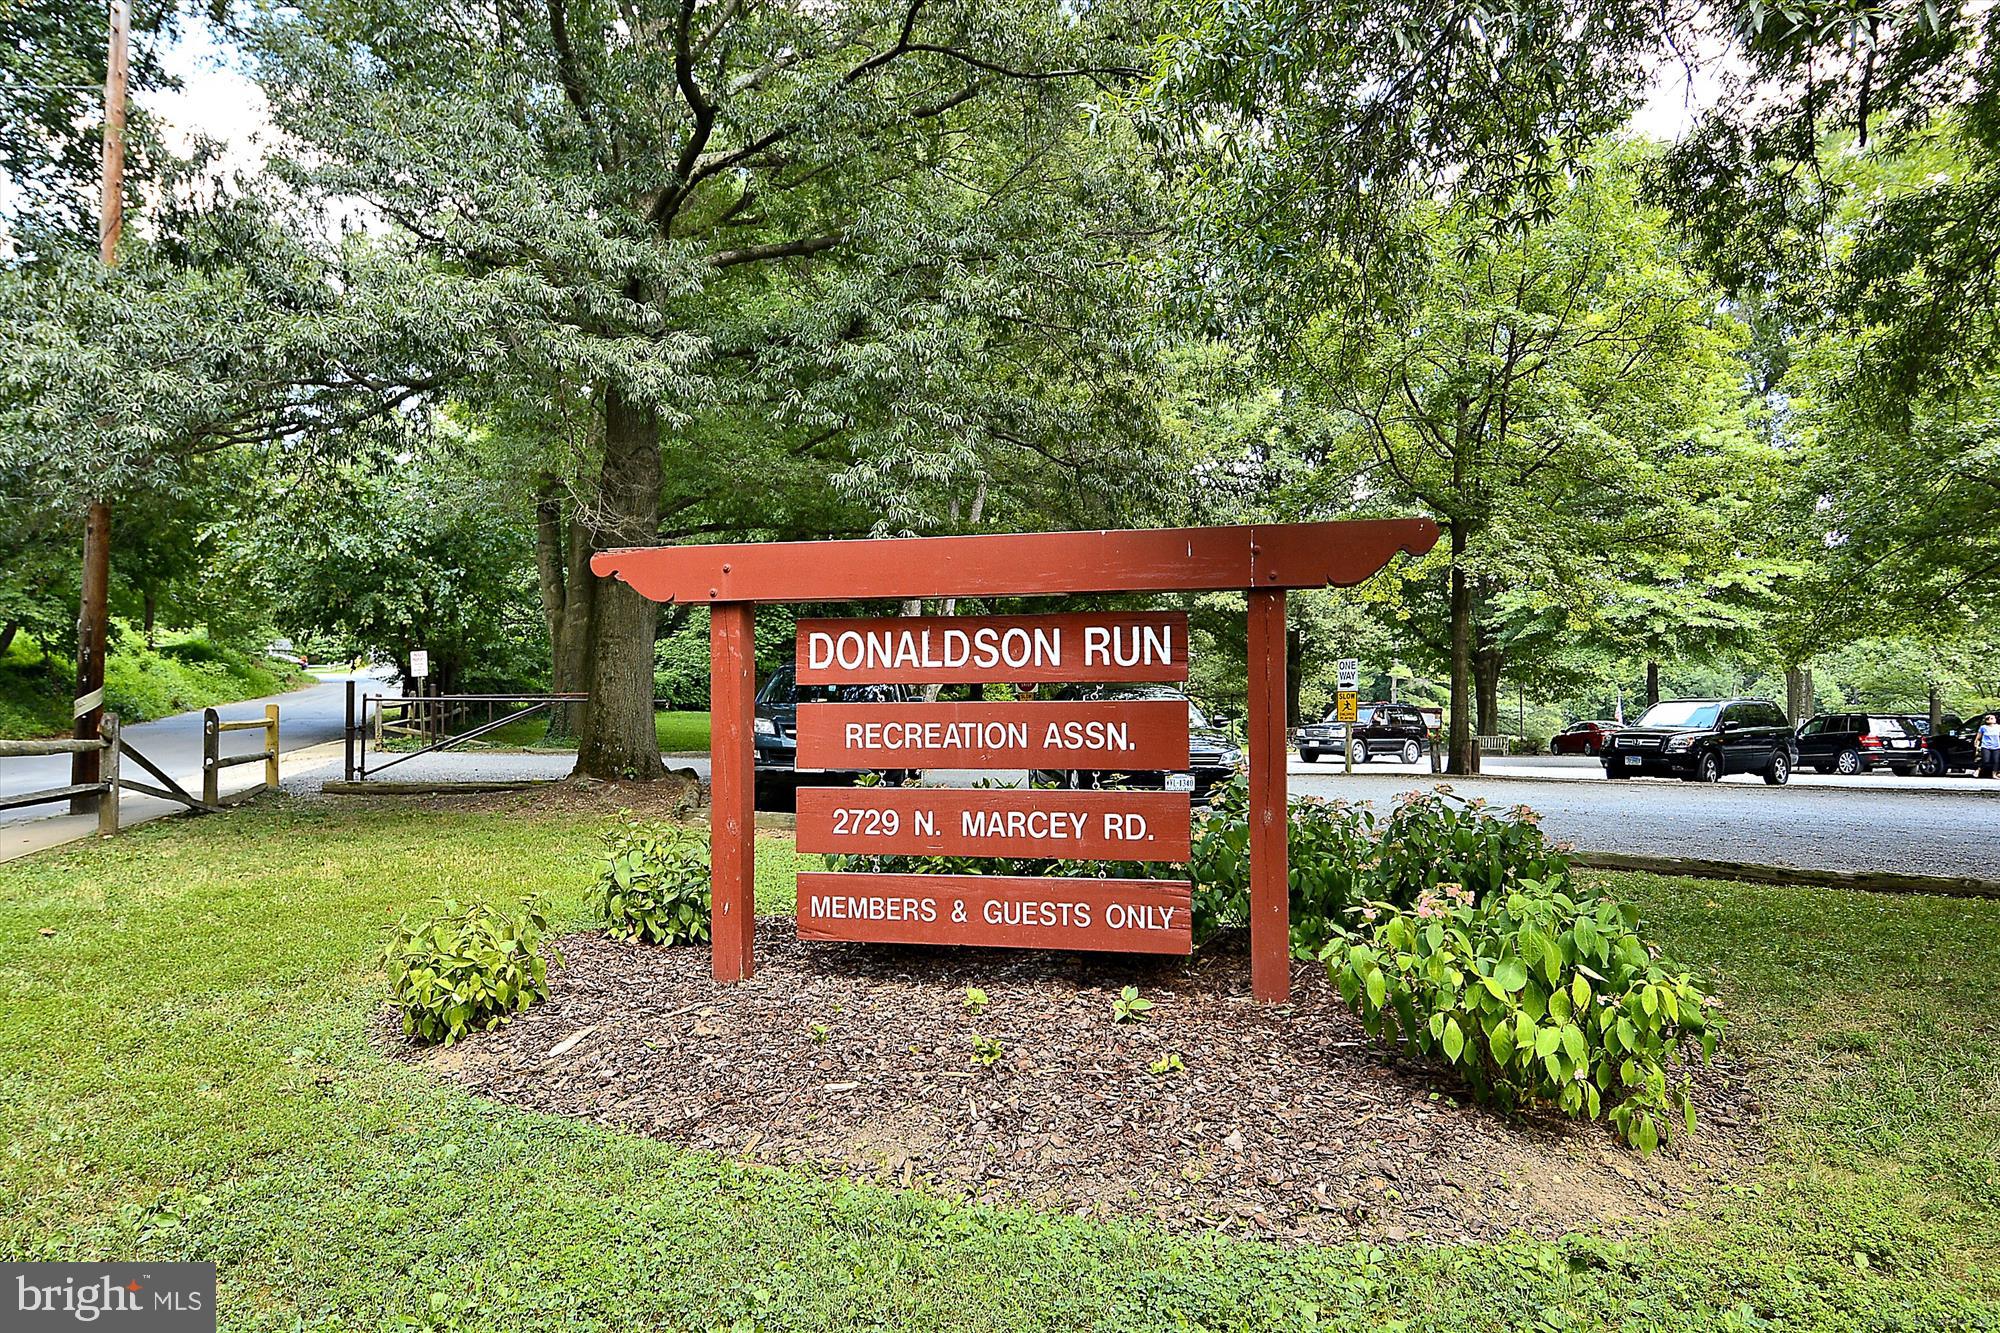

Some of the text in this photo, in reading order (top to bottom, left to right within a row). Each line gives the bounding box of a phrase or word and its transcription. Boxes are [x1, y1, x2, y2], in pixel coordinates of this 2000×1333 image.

[808, 625, 1172, 670] DONALDSON RUN
[1339, 661, 1356, 670] ONE
[1339, 671, 1356, 680] WAY
[845, 721, 1136, 751] RECREATION ASSN.
[832, 808, 1154, 841] 2729 N. MARCEY RD.
[810, 896, 1175, 930] MEMBERS & GUESTS ONLY
